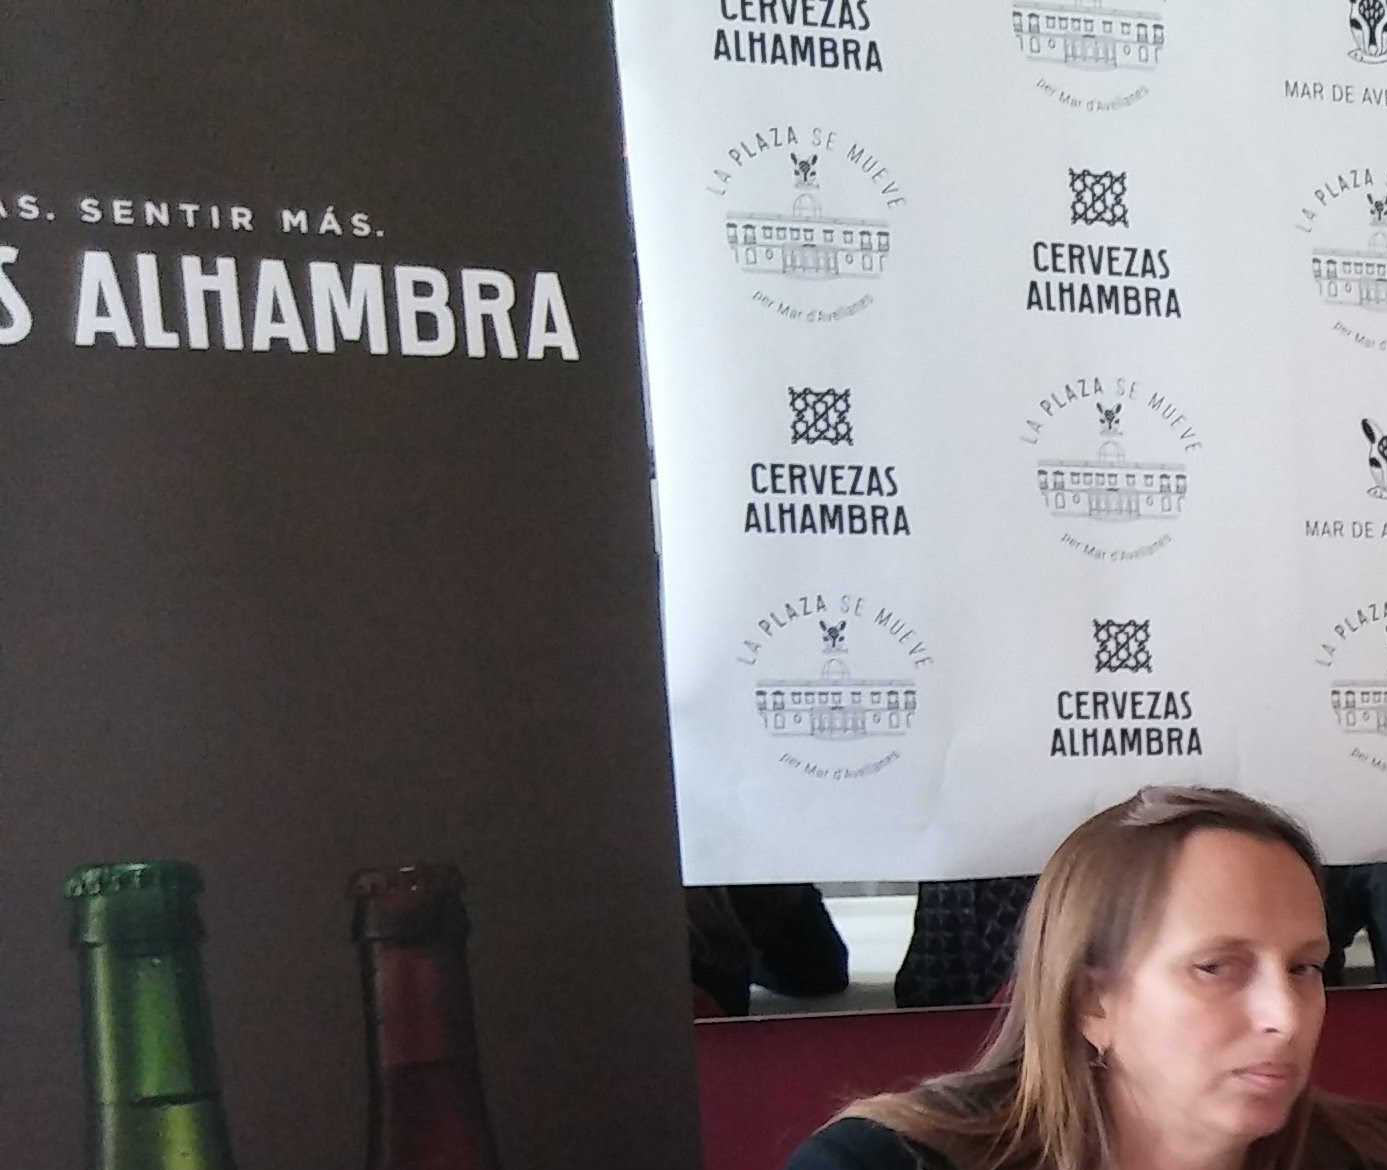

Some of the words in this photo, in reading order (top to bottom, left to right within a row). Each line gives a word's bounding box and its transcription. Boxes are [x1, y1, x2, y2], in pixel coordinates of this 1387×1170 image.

[721, 0, 870, 30] CERVEZAS
[714, 29, 882, 72] ALHAMBRA
[1285, 80, 1323, 100] MAR
[1332, 84, 1354, 103] DE
[705, 168, 731, 196] LA
[729, 126, 798, 166] PLAZA
[812, 128, 836, 150] SE
[847, 144, 905, 208] MUEVE
[80, 198, 253, 230] SENTIR
[282, 206, 384, 236] MÁS.
[1295, 208, 1316, 233] LA
[1315, 169, 1373, 205] PLAZA
[1033, 242, 1169, 279] CERVEZAS
[75, 251, 578, 360] ALHAMBRA
[1027, 281, 1181, 318] ALHAMBRA
[1019, 419, 1042, 444] LA
[1040, 377, 1103, 416] PLAZA
[1117, 378, 1138, 399] SE
[1149, 393, 1201, 451] MUEVE
[751, 463, 897, 496] CERVEZAS
[745, 503, 910, 535] ALHAMBRA
[1306, 521, 1344, 536] MAR
[1352, 521, 1373, 538] DE
[736, 639, 761, 665] LA
[759, 595, 827, 635] PLAZA
[841, 595, 864, 615] SE
[876, 609, 932, 666] MUEVE
[1315, 643, 1336, 667] LA
[1058, 691, 1192, 720] CERVEZAS
[1051, 728, 1202, 756] ALHAMBRA
